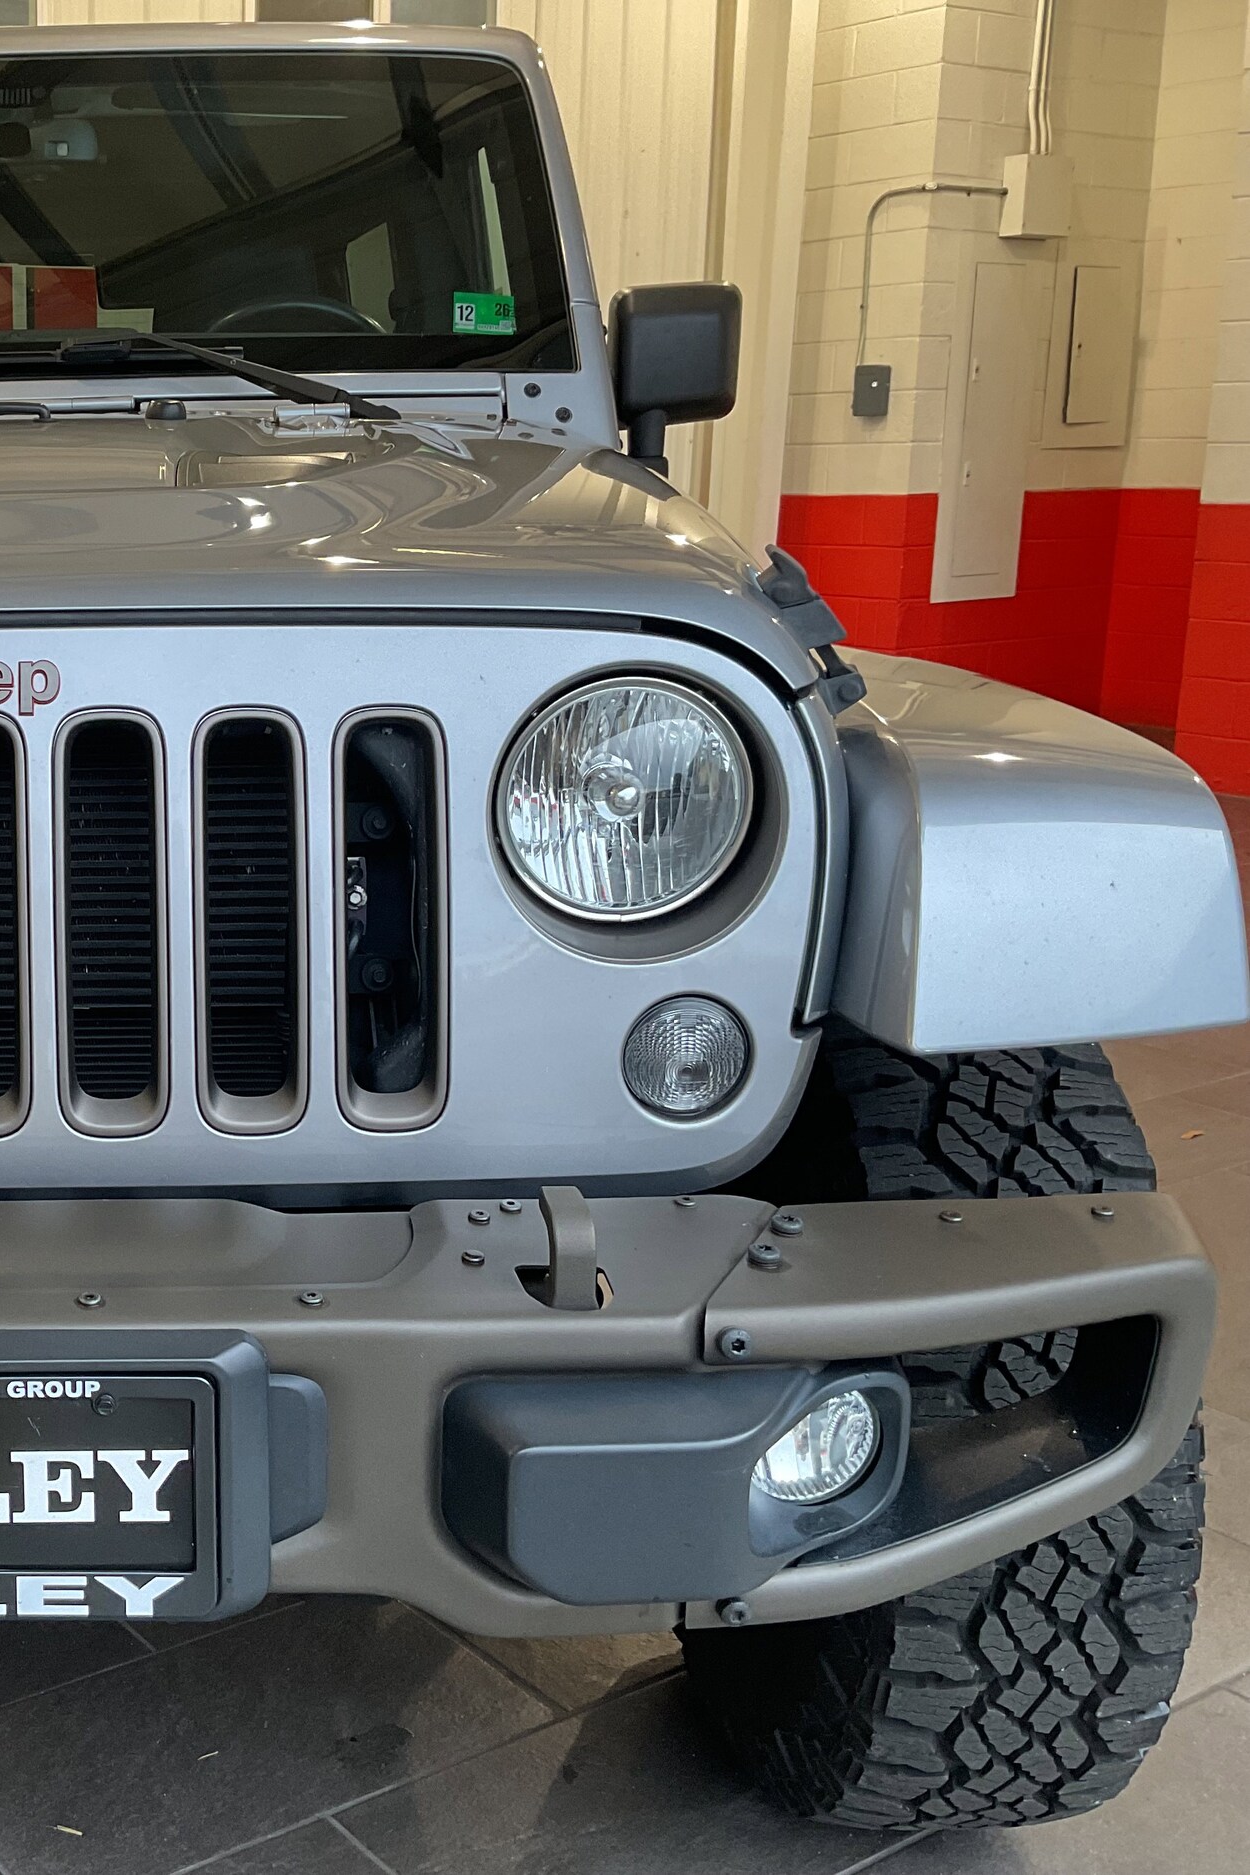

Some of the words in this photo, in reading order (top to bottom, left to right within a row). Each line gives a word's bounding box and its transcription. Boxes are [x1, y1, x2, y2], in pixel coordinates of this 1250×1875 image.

[457, 304, 474, 321] 12
[495, 303, 510, 317] 26
[6, 1380, 101, 1399] GROUP
